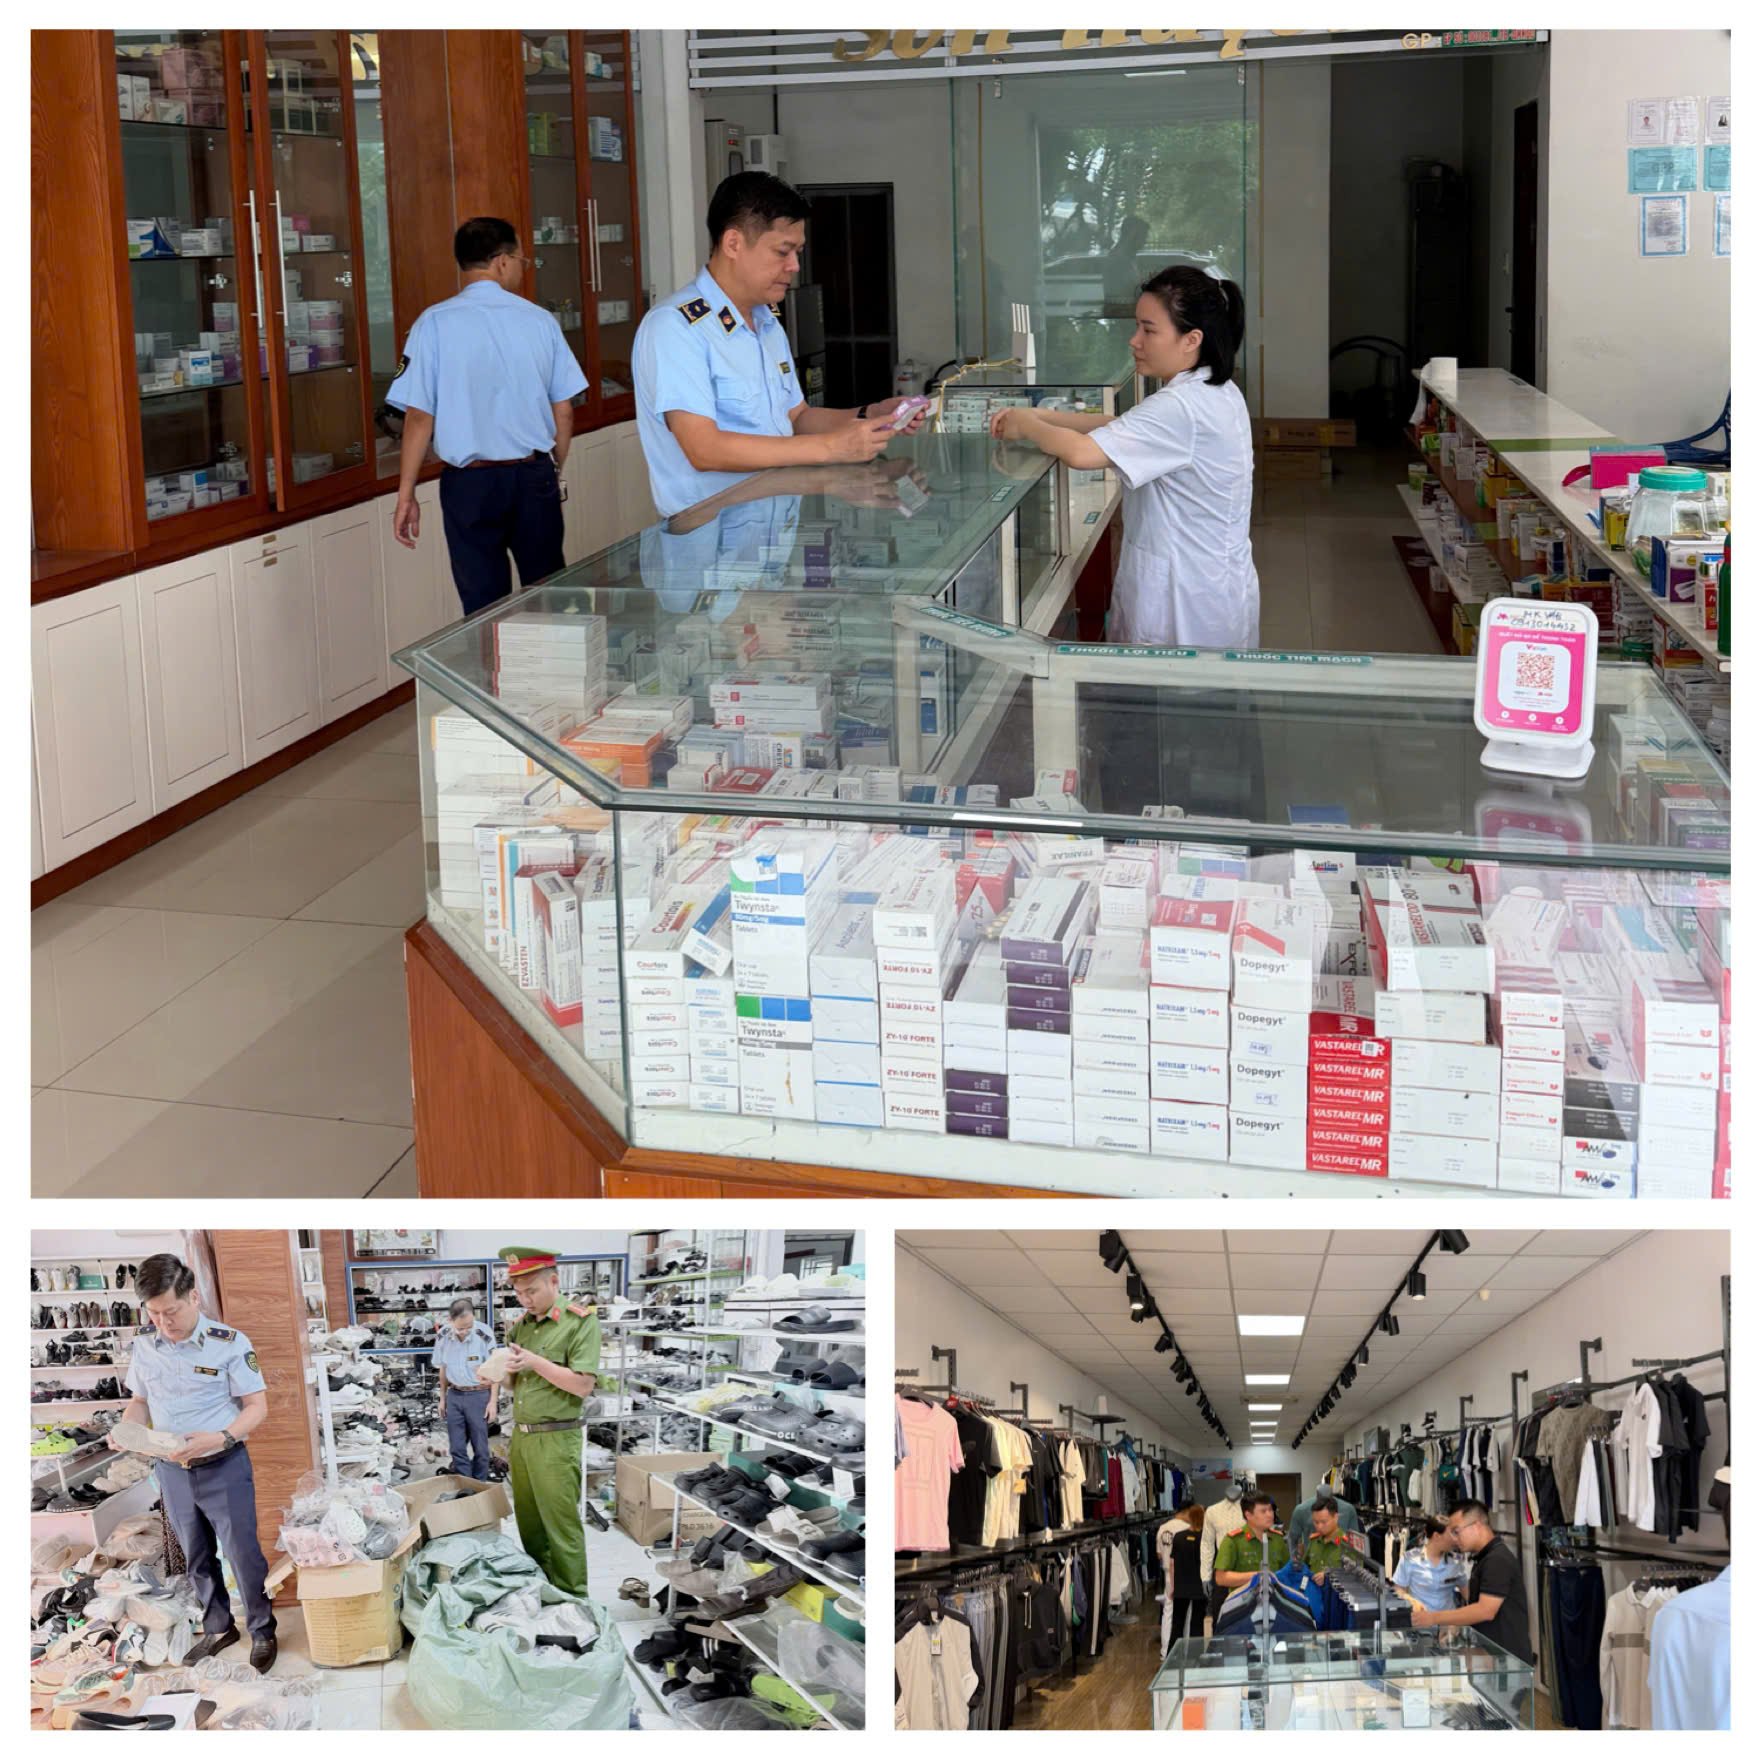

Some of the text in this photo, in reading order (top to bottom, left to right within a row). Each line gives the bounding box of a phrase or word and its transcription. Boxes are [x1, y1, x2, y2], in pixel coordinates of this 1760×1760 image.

[735, 899, 777, 913] Twynsta
[1240, 958, 1286, 973] Dopegyt
[1237, 1012, 1283, 1025] Dopegyt
[741, 1025, 784, 1038] Twynsta
[886, 1032, 935, 1044] ZY-10 FORTE
[887, 1069, 937, 1080] ZY-10 FORTE
[1236, 1064, 1282, 1078] Dopegyt
[1314, 1063, 1385, 1079] VASTAREL MR
[1314, 1086, 1385, 1103] VASTAREL MR
[890, 1105, 940, 1117] ZY-10 FORTE
[1313, 1108, 1384, 1125] VASTAREL MR
[1236, 1117, 1281, 1131] Dopegyt
[1312, 1130, 1383, 1147] VASTAREL MR
[1311, 1153, 1382, 1170] VASTAREL MR
